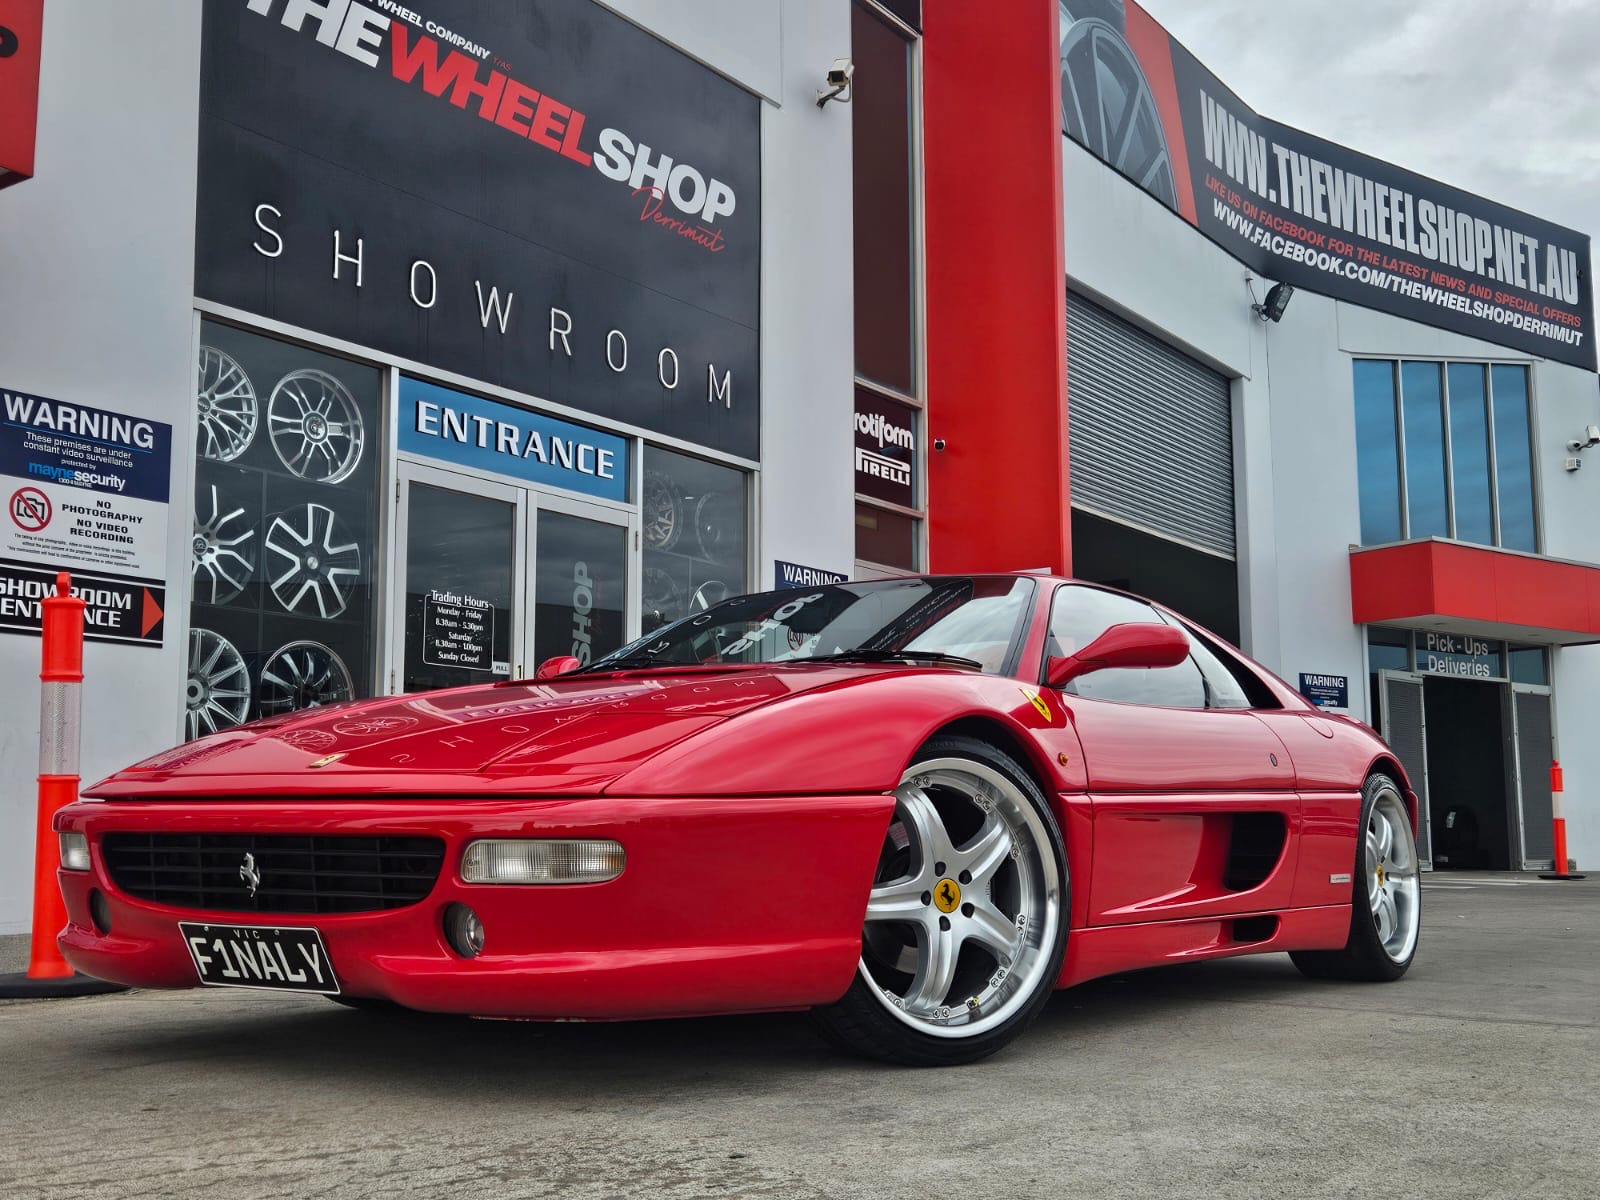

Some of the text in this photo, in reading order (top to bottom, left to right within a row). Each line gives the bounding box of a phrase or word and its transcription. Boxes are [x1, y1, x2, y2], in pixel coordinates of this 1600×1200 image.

[377, 0, 423, 27] WHEEL
[425, 21, 491, 59] COMPANY
[247, 0, 392, 68] HE
[594, 127, 736, 224] SHOP
[1200, 89, 1578, 305] WWW.THEWHEELSHOP.NET.AU
[631, 186, 725, 252] Derrimut
[1205, 172, 1582, 328] LIKE US ON FACEBOOK FOR THE LATEST NEWS AND SPECIAL OFFERS
[1213, 197, 1583, 347] WWW.FACEBOOK.COM/THEWHEELSHOPDERRIMUT
[253, 203, 732, 410] SHOWROOM
[4, 393, 154, 449] WARNING
[854, 412, 913, 450] rotiform
[26, 431, 131, 460] These premises are under
[416, 400, 614, 480] ENTRANCE
[24, 441, 133, 468] constant video surveillance
[61, 459, 88, 469] protected
[855, 446, 911, 486] PIRELLI
[62, 503, 143, 525] PHOTOGRAPHY
[96, 500, 112, 510] NO
[70, 527, 134, 544] RECORDING
[76, 518, 128, 534] NO VIDEO
[0, 598, 122, 628] ENTNCE
[431, 590, 489, 608] Trading Hours
[437, 606, 460, 618] Monday
[465, 610, 482, 621] Friday
[462, 621, 484, 632] 5.30pm
[571, 561, 593, 669] SHOP
[448, 631, 472, 643] Saturday
[1427, 633, 1454, 653] Pick
[1464, 636, 1488, 659] Ups
[438, 650, 479, 663] Sunday Closed
[1428, 655, 1490, 678] Deliveries
[1304, 674, 1344, 688] WARNING
[233, 929, 260, 940] VIC
[189, 937, 324, 984] F1NALY
